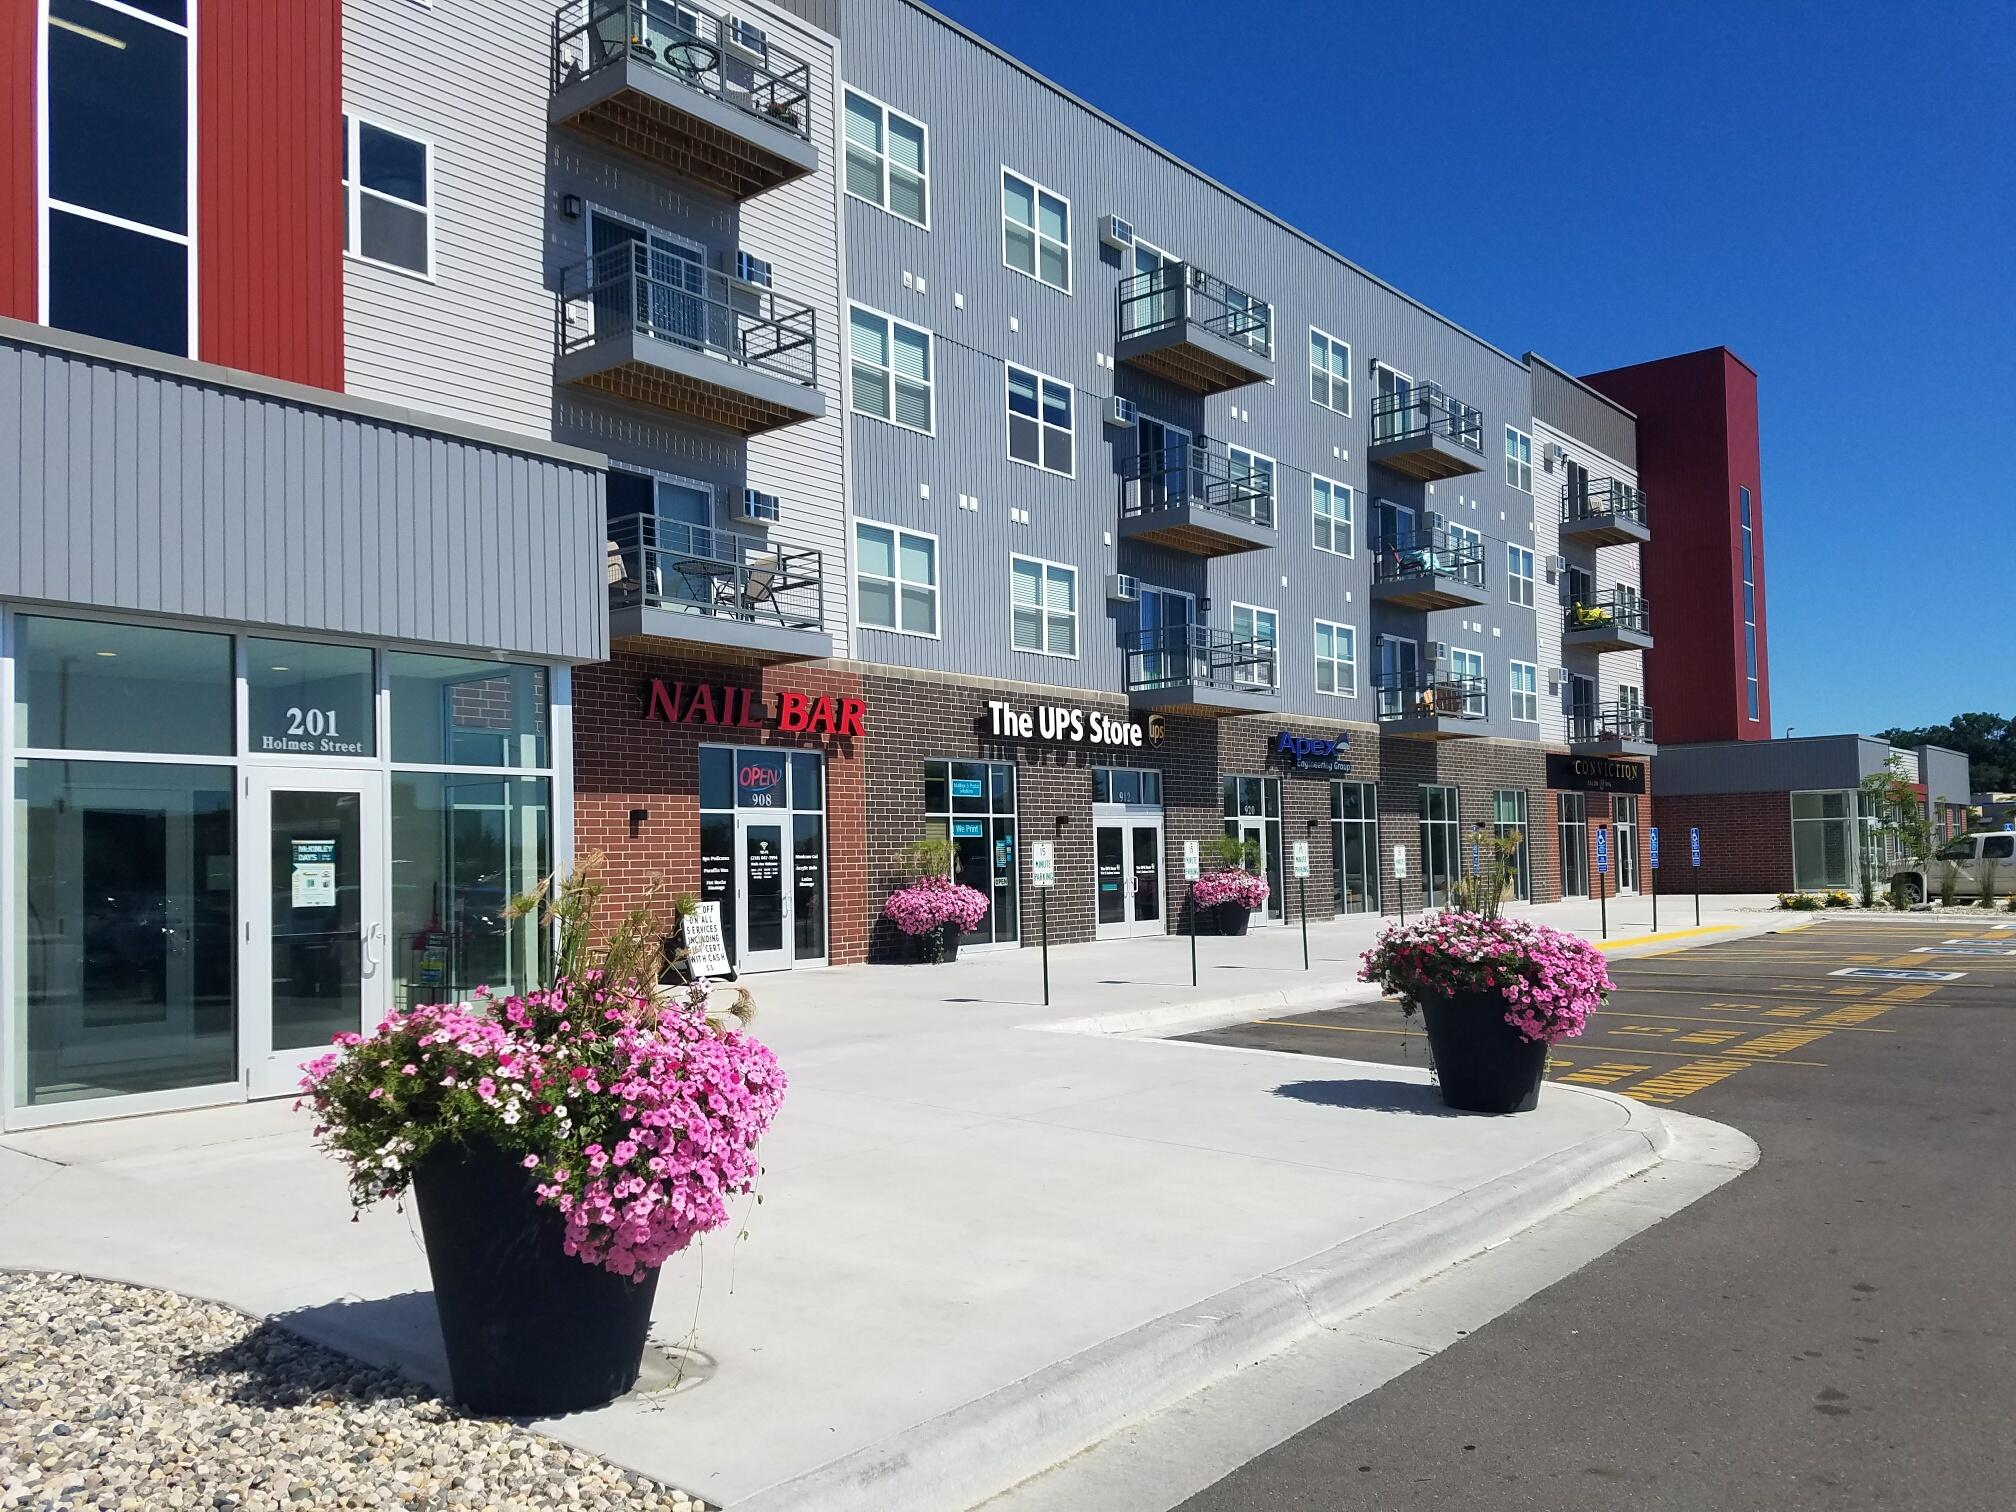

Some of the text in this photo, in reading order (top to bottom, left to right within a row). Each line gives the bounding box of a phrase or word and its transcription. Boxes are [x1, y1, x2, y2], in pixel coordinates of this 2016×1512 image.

[645, 677, 867, 737] NAIL BAR
[286, 707, 340, 737] 201
[988, 700, 1143, 747] The UPS Store
[1150, 725, 1164, 743] ups
[262, 735, 362, 753] Holmes Street
[1277, 731, 1338, 760] Apex
[1296, 760, 1351, 772] Engineering Group
[1575, 760, 1638, 779] CONVICTION
[739, 767, 778, 786] OPEN
[751, 794, 772, 807] 908
[1244, 805, 1256, 816] 920
[955, 824, 979, 833] We Print
[298, 853, 318, 861] DAYS
[1040, 847, 1046, 856] 15
[1035, 860, 1051, 869] MINUTE
[995, 878, 1008, 886] OPEN
[1034, 872, 1053, 881] PARKING
[702, 905, 714, 914] OFF
[689, 915, 713, 925] ON ALL
[686, 924, 718, 935] SERVICES
[705, 943, 724, 953] CERT.
[690, 953, 726, 964] WITH CASH
[1607, 1025, 1681, 1037] 15
